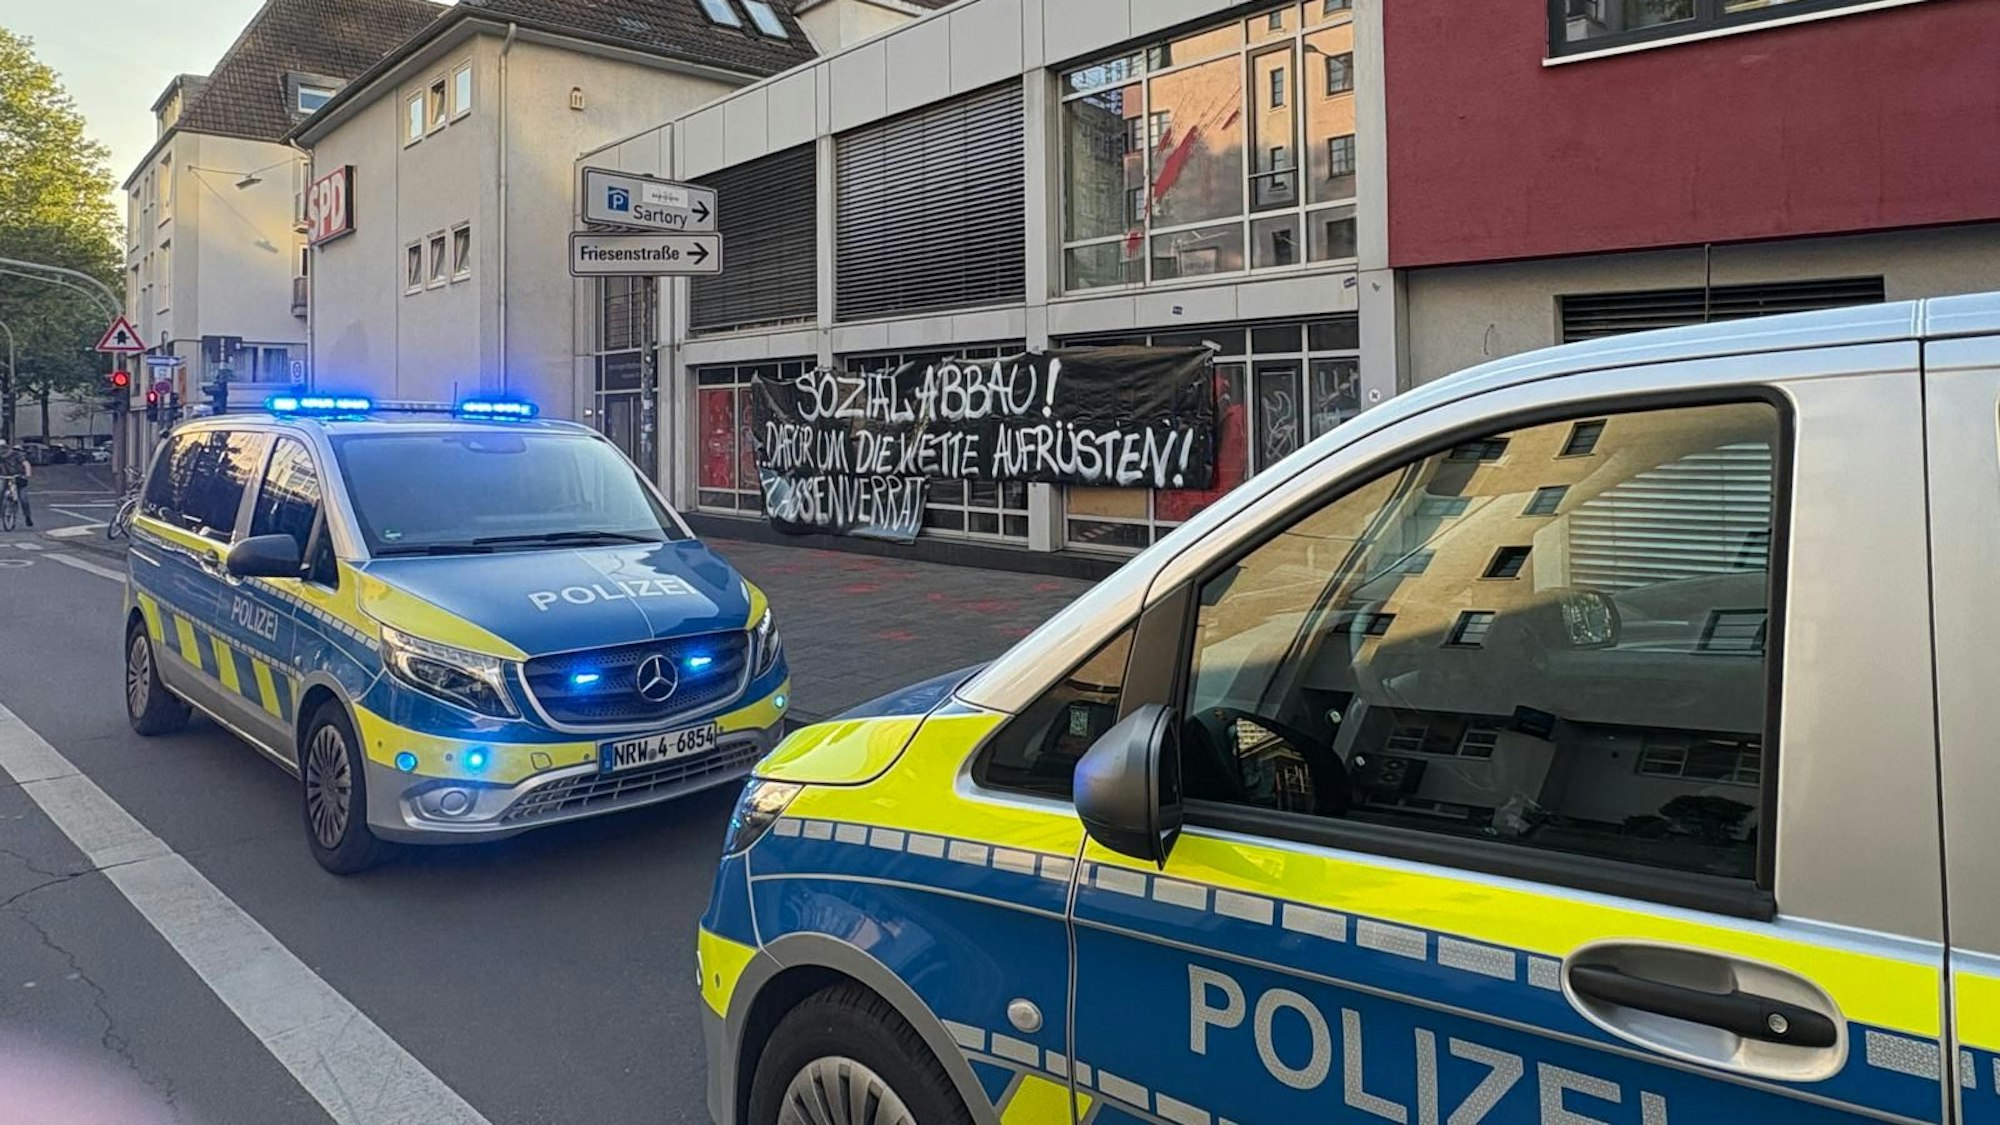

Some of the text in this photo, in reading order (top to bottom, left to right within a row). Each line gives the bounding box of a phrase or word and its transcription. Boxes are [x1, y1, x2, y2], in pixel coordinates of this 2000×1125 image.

[309, 173, 345, 241] SPD
[613, 194, 624, 209] P
[633, 204, 688, 229] Sartory
[580, 245, 680, 262] Friesenstraße
[817, 429, 849, 473] UM
[856, 430, 894, 474] DIE
[895, 431, 979, 479] WETTE
[992, 420, 1194, 487] AUFRÜSTEN!
[528, 579, 697, 611] POLIZEI
[231, 595, 278, 642] POLIZEI
[614, 726, 714, 767] NRW 4-6854
